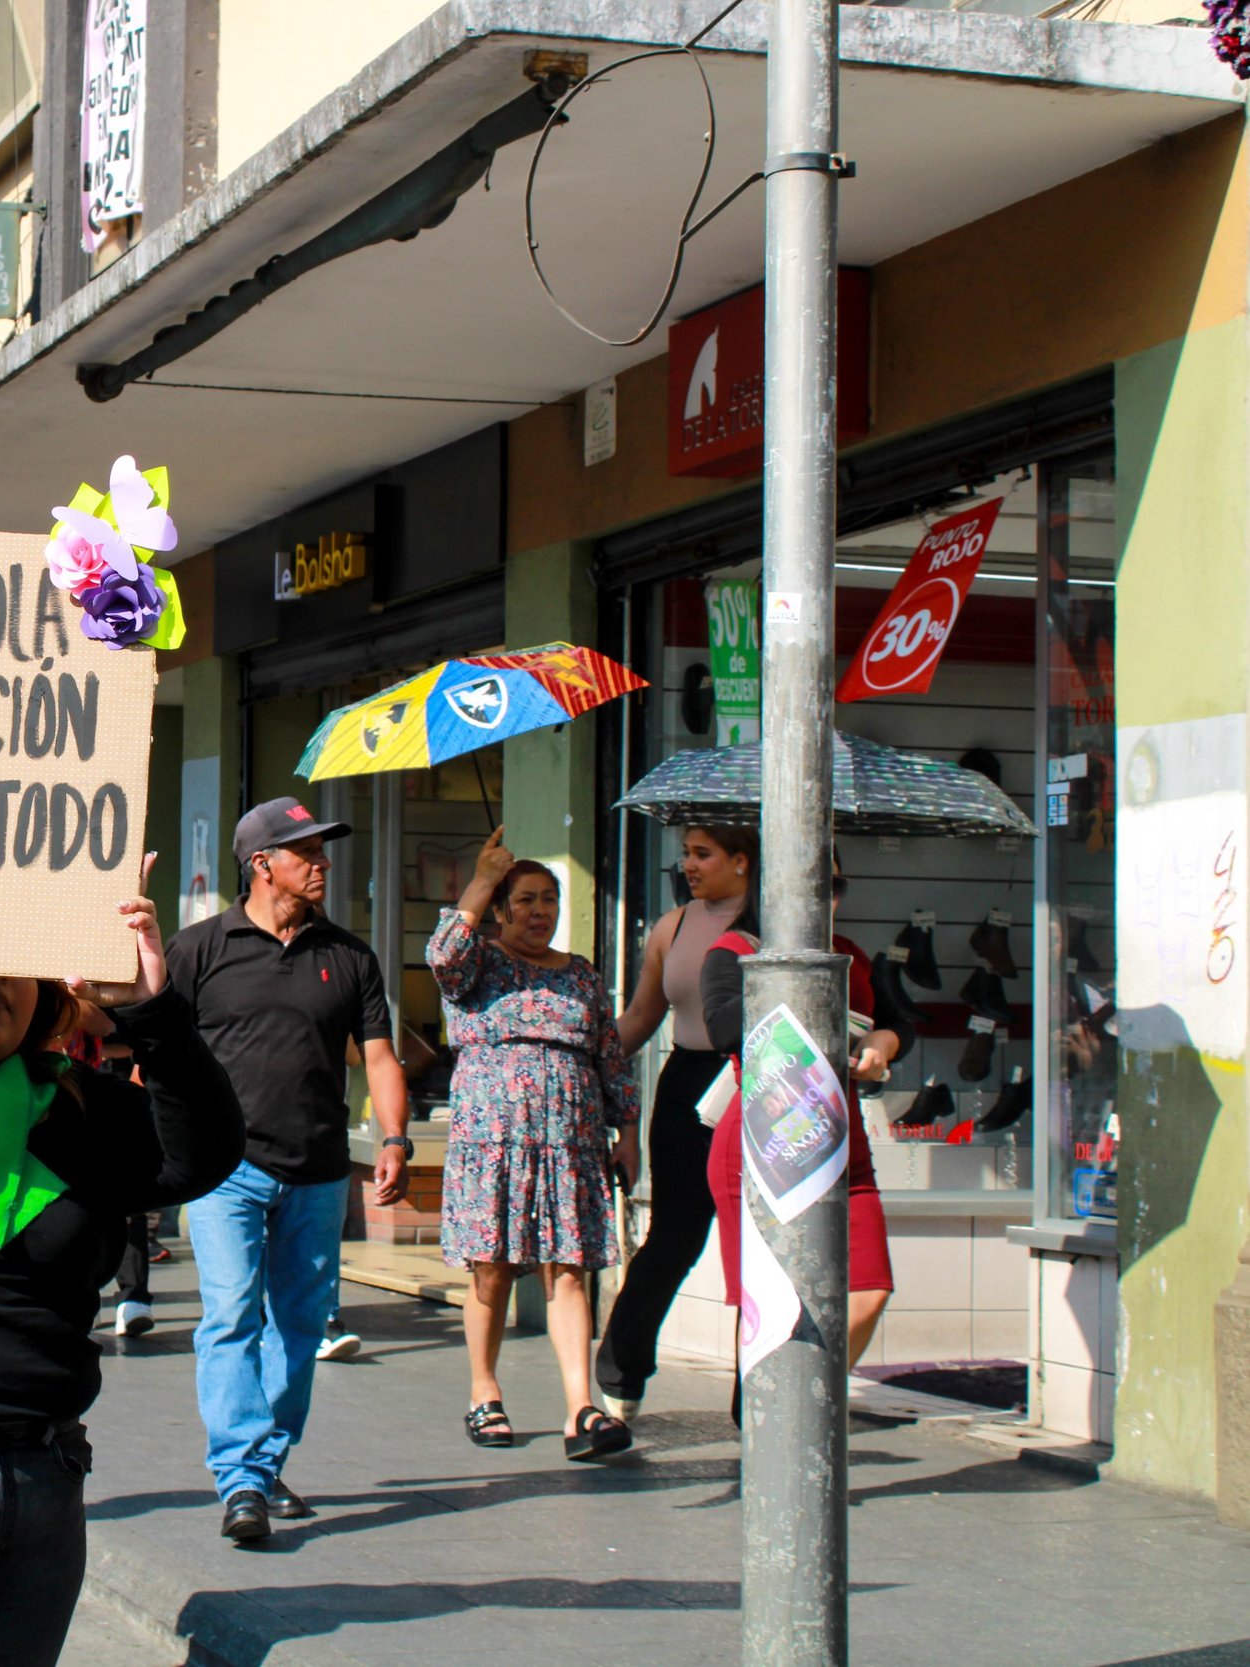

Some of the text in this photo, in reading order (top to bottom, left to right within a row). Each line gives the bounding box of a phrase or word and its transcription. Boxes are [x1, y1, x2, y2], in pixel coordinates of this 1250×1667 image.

[683, 398, 763, 453] DE LA TOR
[919, 518, 980, 556] PUNTO
[927, 532, 984, 574] ROJO
[275, 531, 356, 600] Le Bolshá
[869, 608, 947, 663] 30%
[729, 650, 747, 673] de
[715, 677, 759, 702] DESCUENT
[1069, 696, 1114, 728] TOR
[887, 1122, 947, 1140] TORRE
[1075, 1141, 1093, 1161] DE
